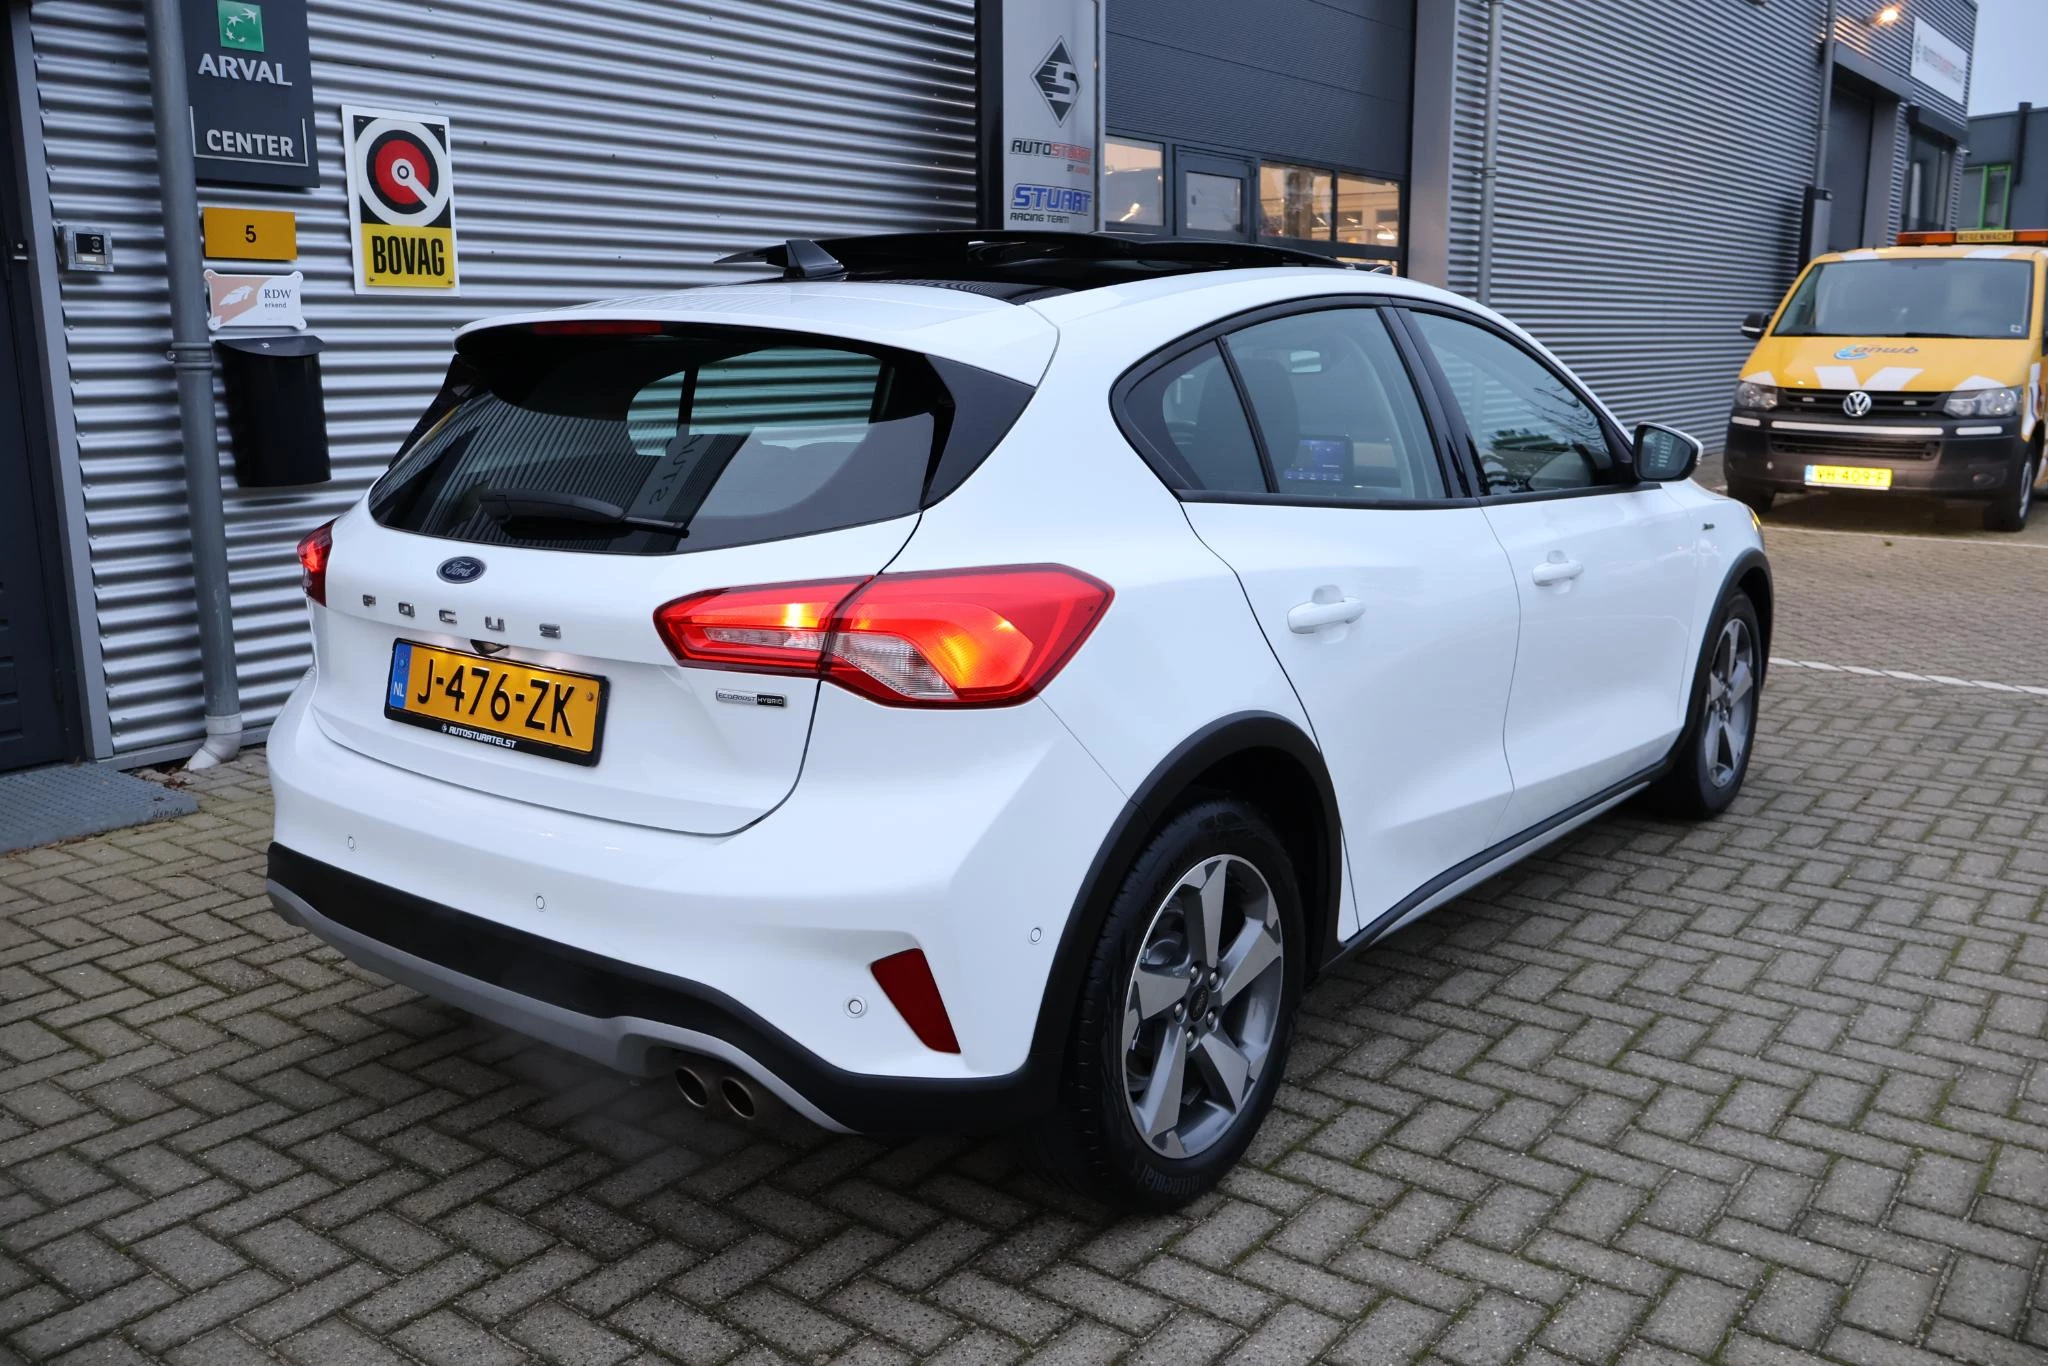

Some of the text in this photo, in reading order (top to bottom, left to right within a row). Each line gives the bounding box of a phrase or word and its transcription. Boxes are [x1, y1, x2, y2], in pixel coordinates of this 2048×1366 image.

[198, 53, 293, 87] ARVAL
[206, 129, 294, 158] CENTER
[1012, 184, 1092, 215] STUART
[1010, 212, 1070, 224] RACING TEAM
[244, 224, 257, 243] 5
[371, 235, 445, 277] BOVAG
[264, 288, 291, 299] RDW
[445, 560, 476, 577] Ford
[362, 593, 562, 640] FOCUS
[393, 658, 575, 738] NL J-476-ZK
[757, 696, 783, 705] HYBRID
